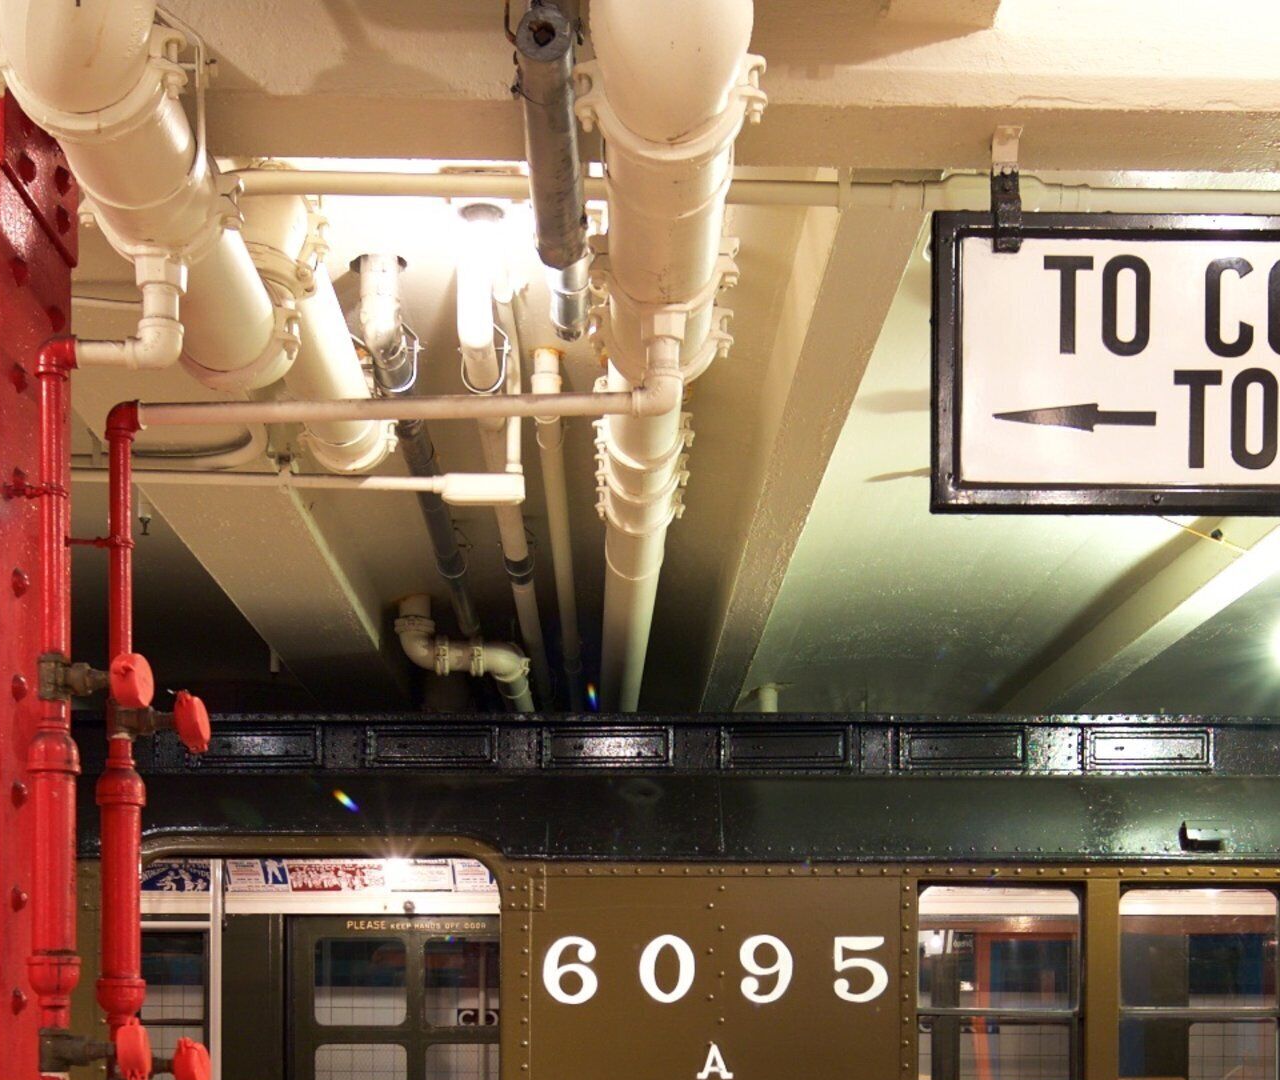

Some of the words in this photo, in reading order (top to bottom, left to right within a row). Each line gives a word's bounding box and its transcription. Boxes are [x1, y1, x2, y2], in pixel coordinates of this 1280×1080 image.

[1044, 255, 1150, 357] TO
[1175, 370, 1278, 469] TO
[347, 920, 386, 930] PLEASE
[390, 922, 411, 930] KEEP
[414, 922, 441, 930] HANDS
[445, 922, 460, 930] OFF
[543, 935, 888, 1004] 6095
[697, 1043, 733, 1080] A
